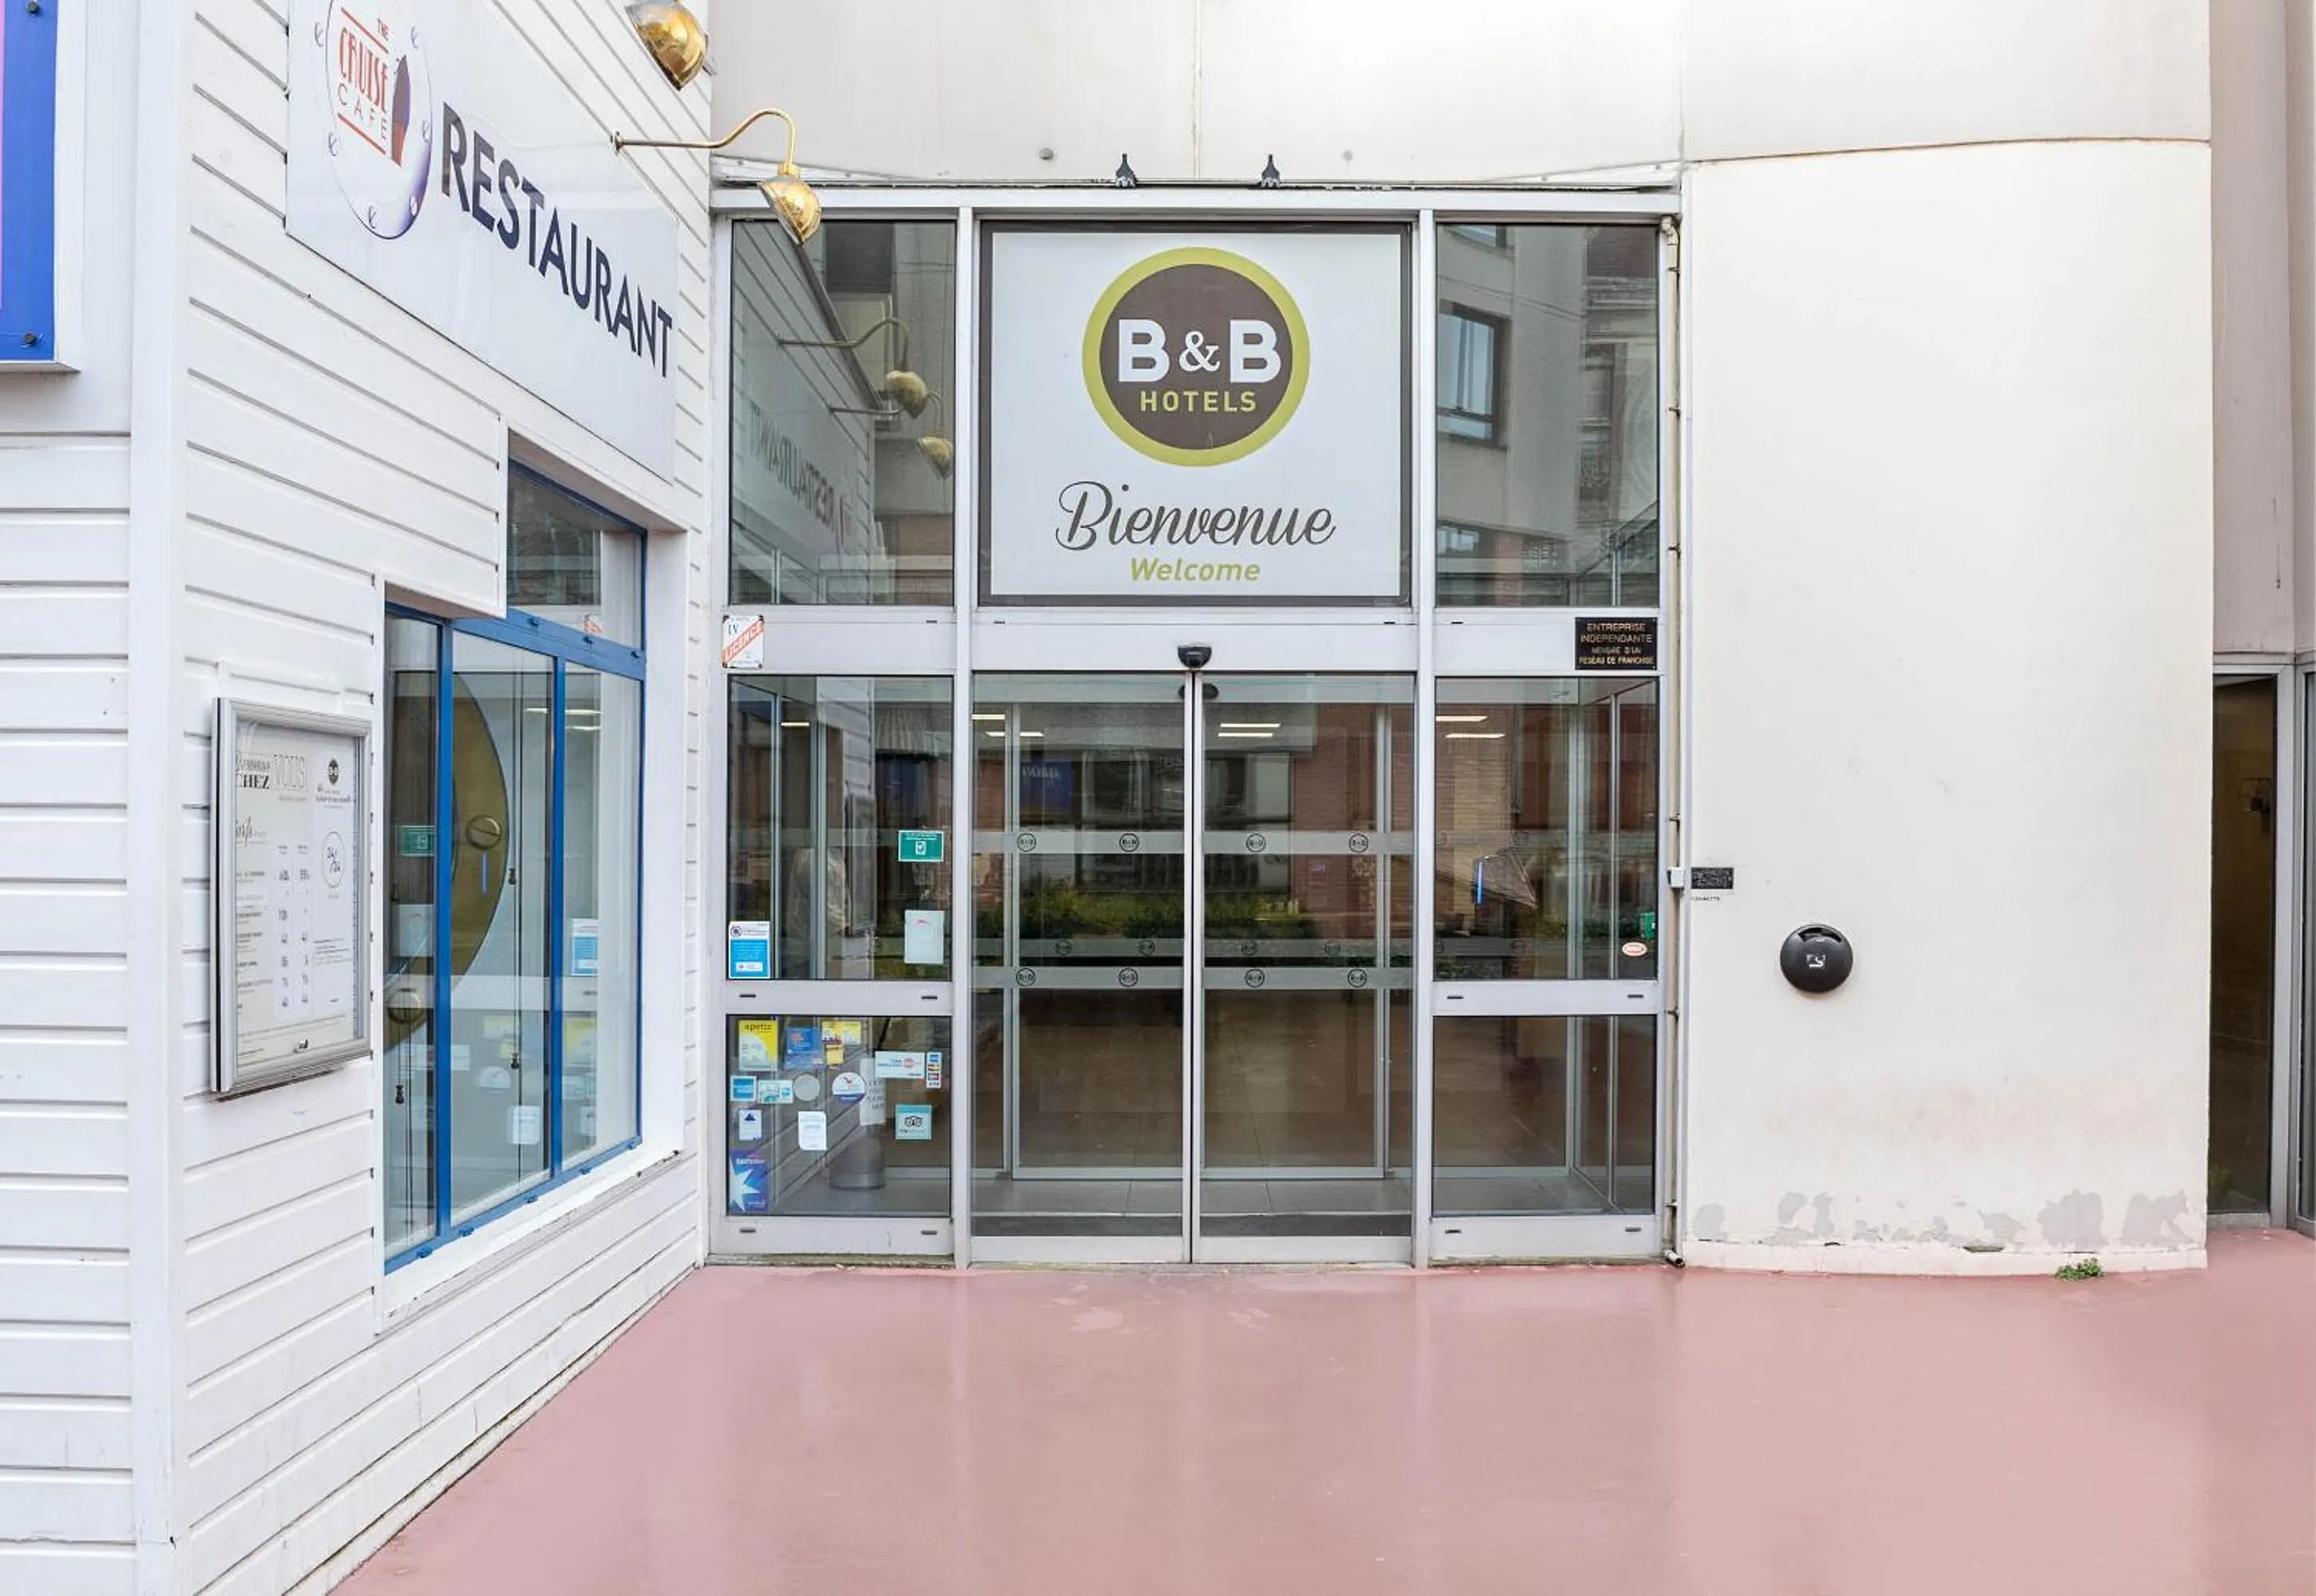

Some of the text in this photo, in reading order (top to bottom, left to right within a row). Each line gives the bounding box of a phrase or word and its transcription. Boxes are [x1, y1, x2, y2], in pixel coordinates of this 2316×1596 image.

[377, 18, 391, 41] THE
[339, 27, 388, 115] CRUISE
[441, 101, 672, 378] RESTAURANT
[1140, 390, 1256, 412] HOTELS
[1056, 481, 1337, 551] Bienvenue
[1130, 558, 1260, 581] Welcome
[1587, 623, 1646, 632] ENTREPRISE
